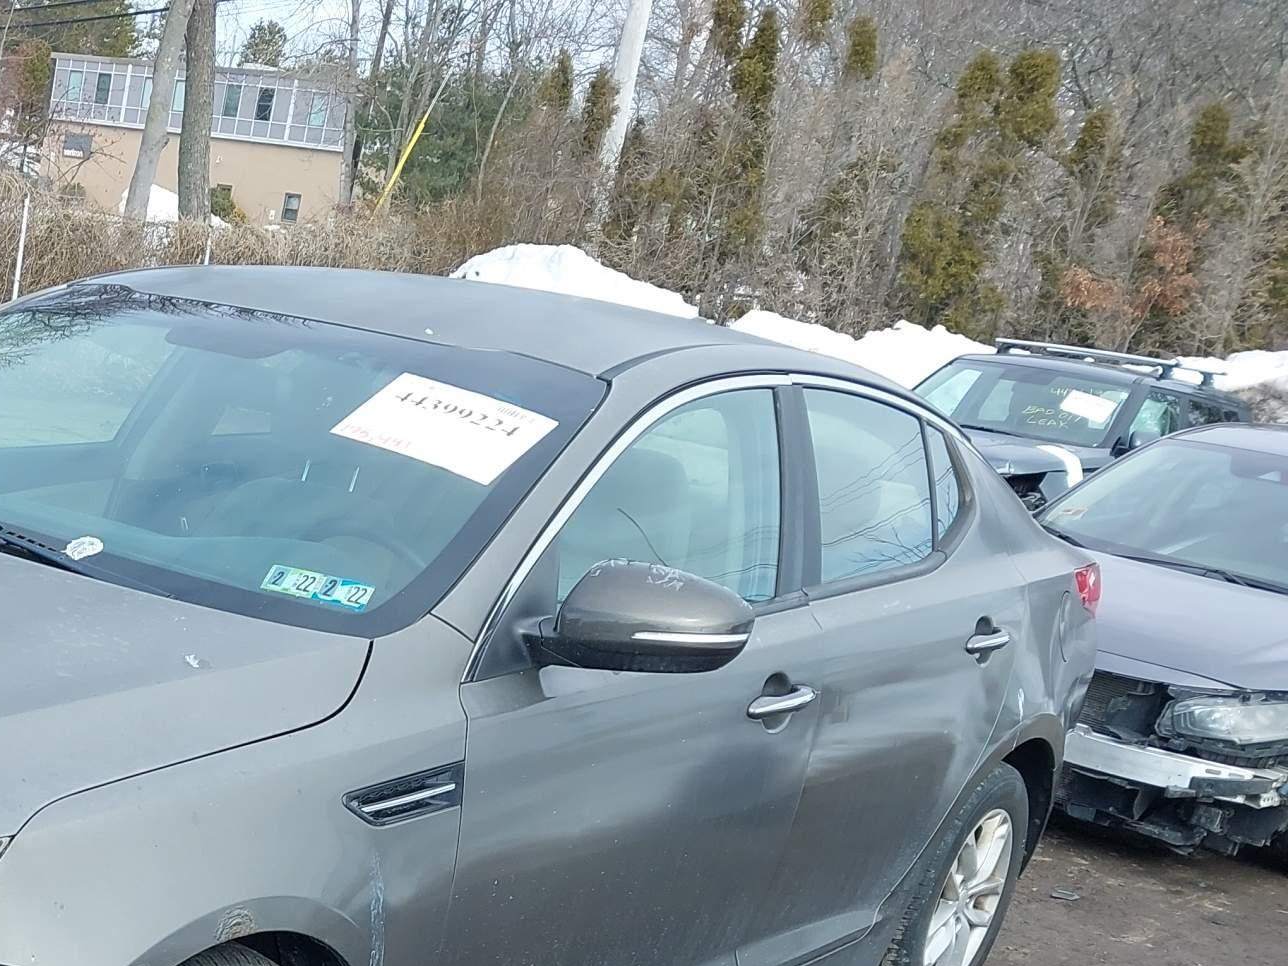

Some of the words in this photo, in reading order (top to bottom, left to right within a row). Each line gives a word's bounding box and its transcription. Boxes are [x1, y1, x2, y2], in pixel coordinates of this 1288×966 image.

[395, 391, 521, 437] 44399224
[272, 571, 285, 586] 2
[296, 574, 317, 593] 22
[323, 579, 338, 597] 2
[348, 586, 368, 605] 22
